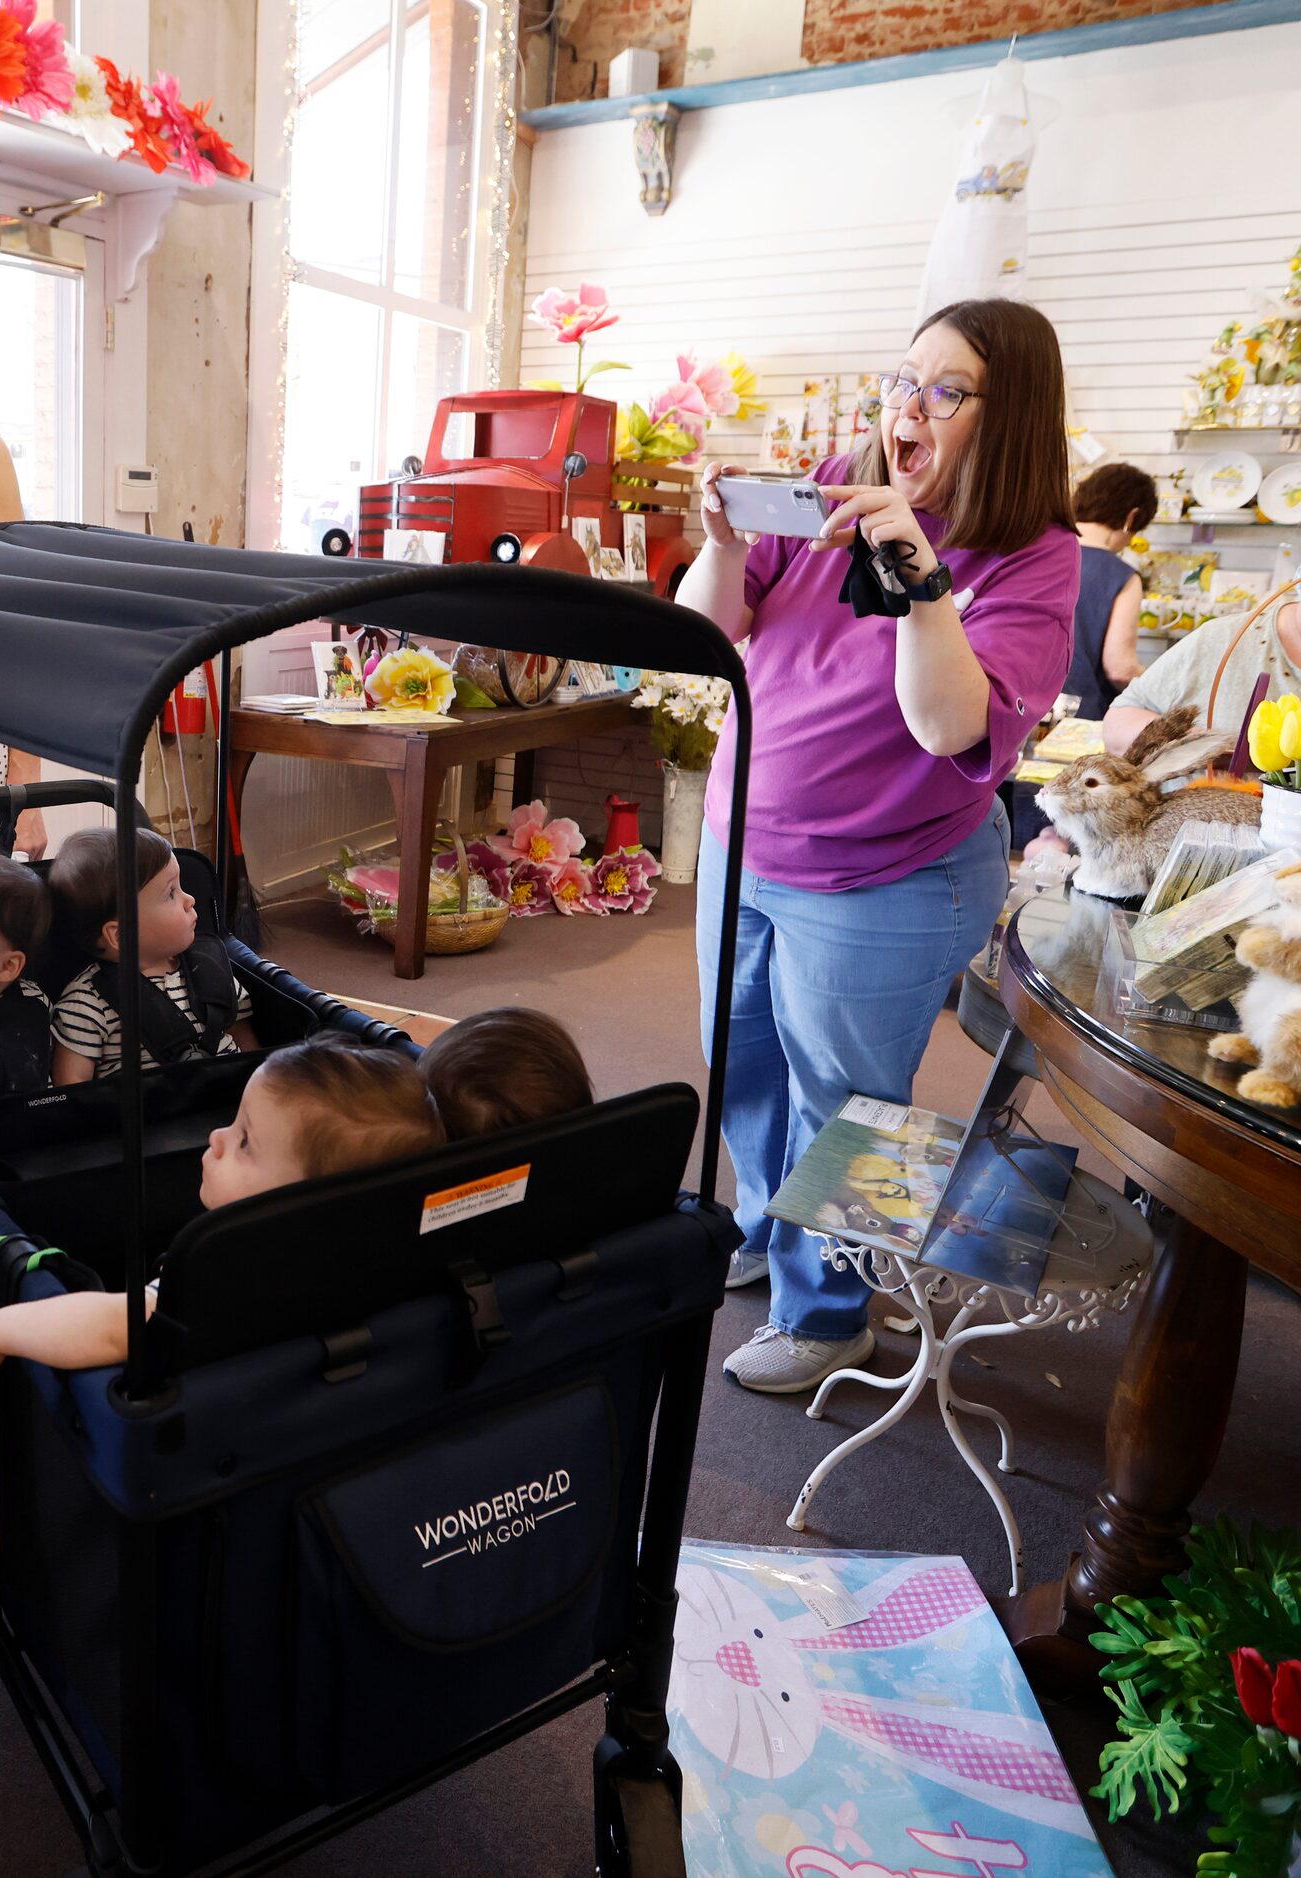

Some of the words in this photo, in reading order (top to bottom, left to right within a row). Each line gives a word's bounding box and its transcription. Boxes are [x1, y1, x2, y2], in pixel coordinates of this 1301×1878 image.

[455, 1183, 494, 1199] WARNING
[414, 1469, 571, 1550] WONDERFOLD
[467, 1513, 536, 1555] WAGON
